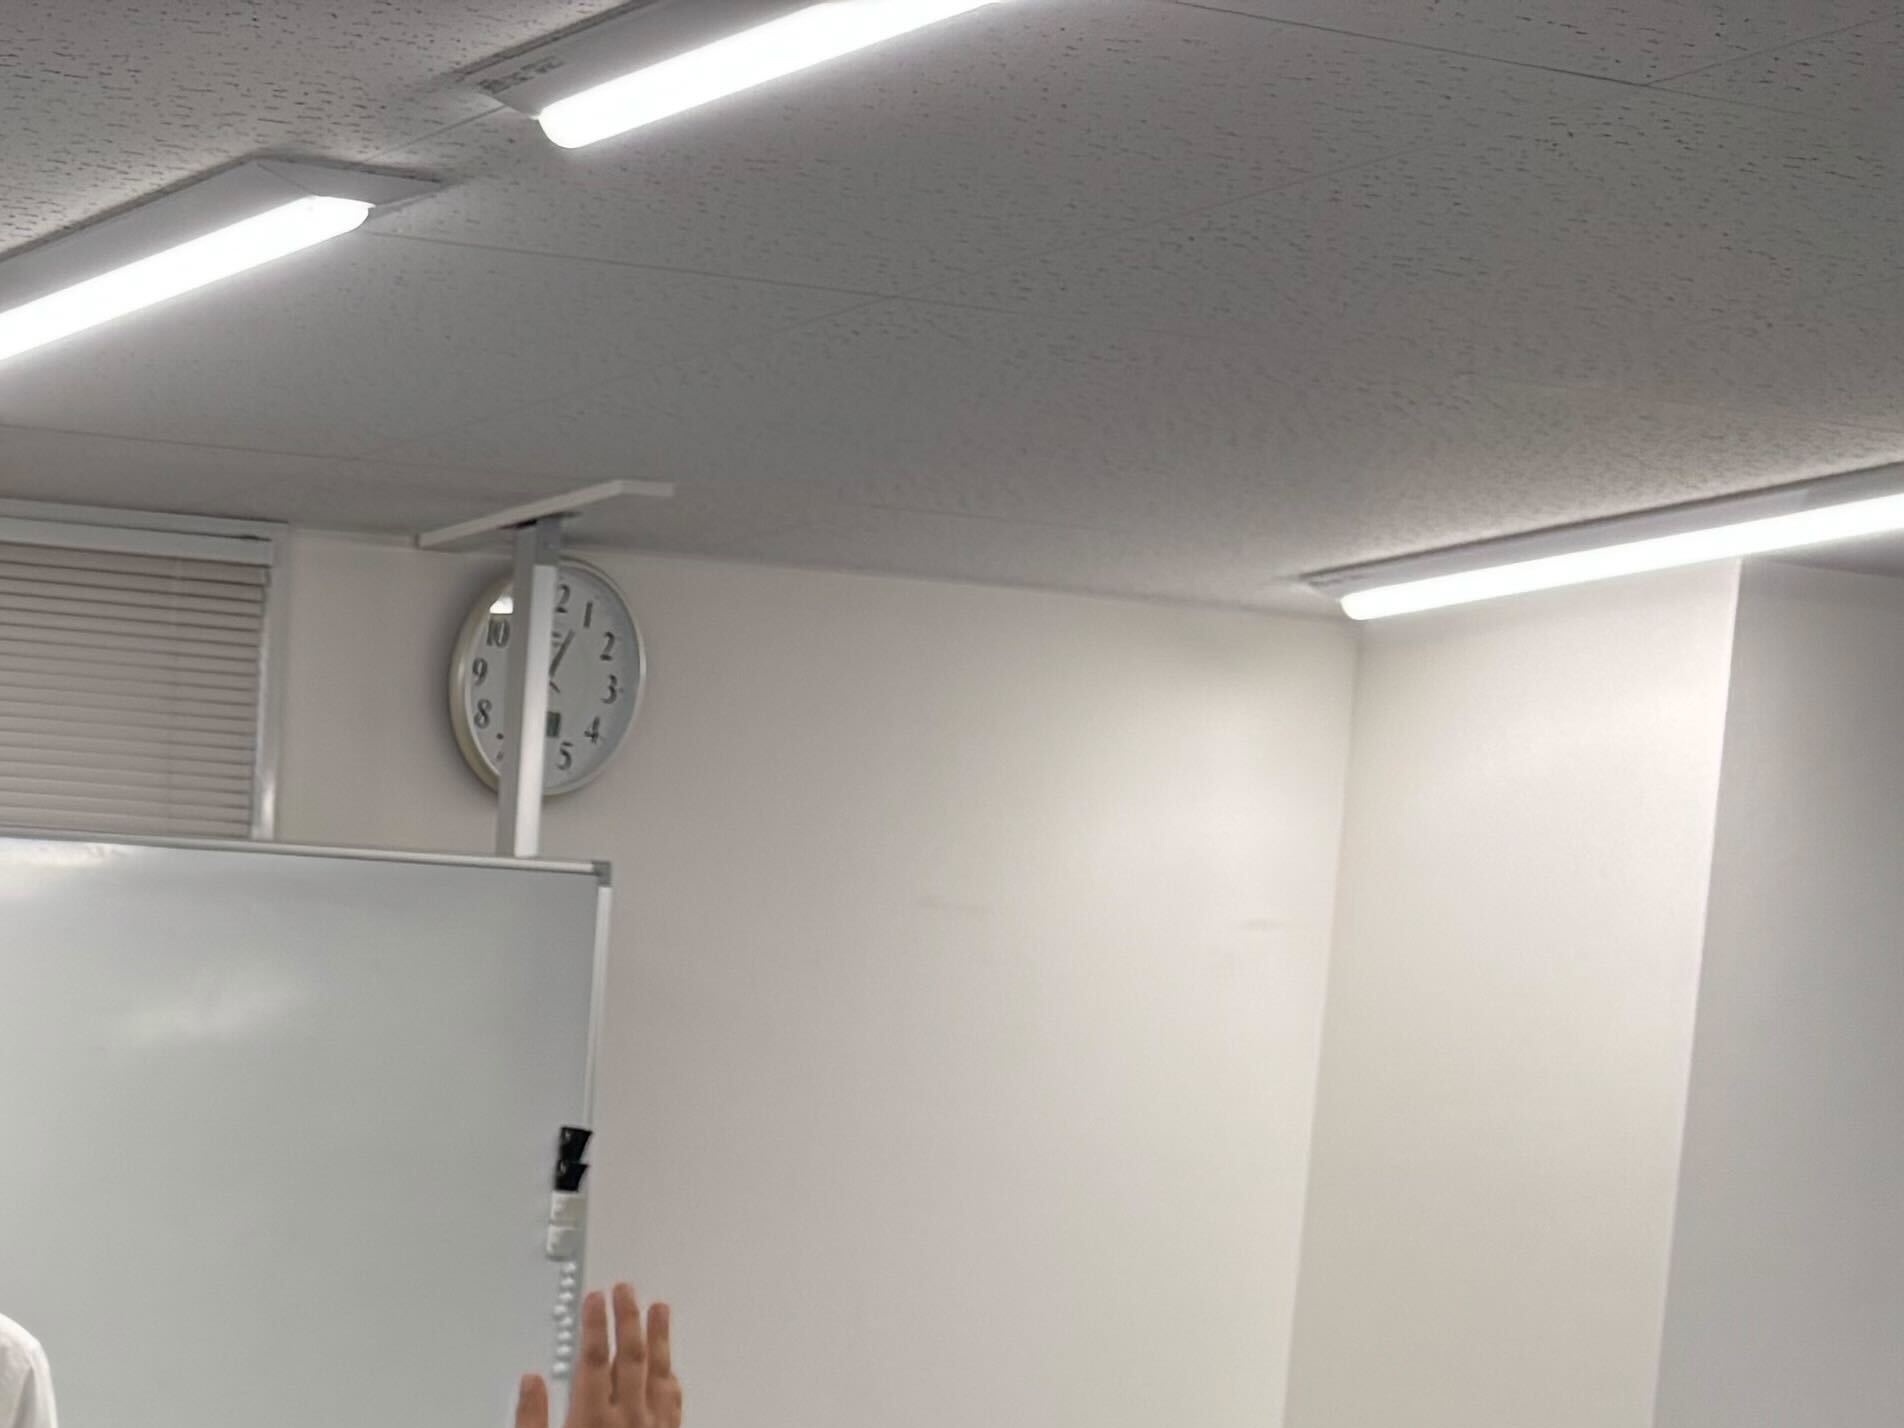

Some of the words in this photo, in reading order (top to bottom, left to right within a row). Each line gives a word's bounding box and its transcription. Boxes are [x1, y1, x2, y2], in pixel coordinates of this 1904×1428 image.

[584, 602, 593, 628] 1
[486, 620, 510, 648] 10
[600, 632, 615, 661] 2
[472, 657, 488, 686] 9
[601, 674, 618, 704] 3
[474, 699, 492, 728] 8
[584, 716, 600, 744] 4
[558, 741, 573, 770] 5
